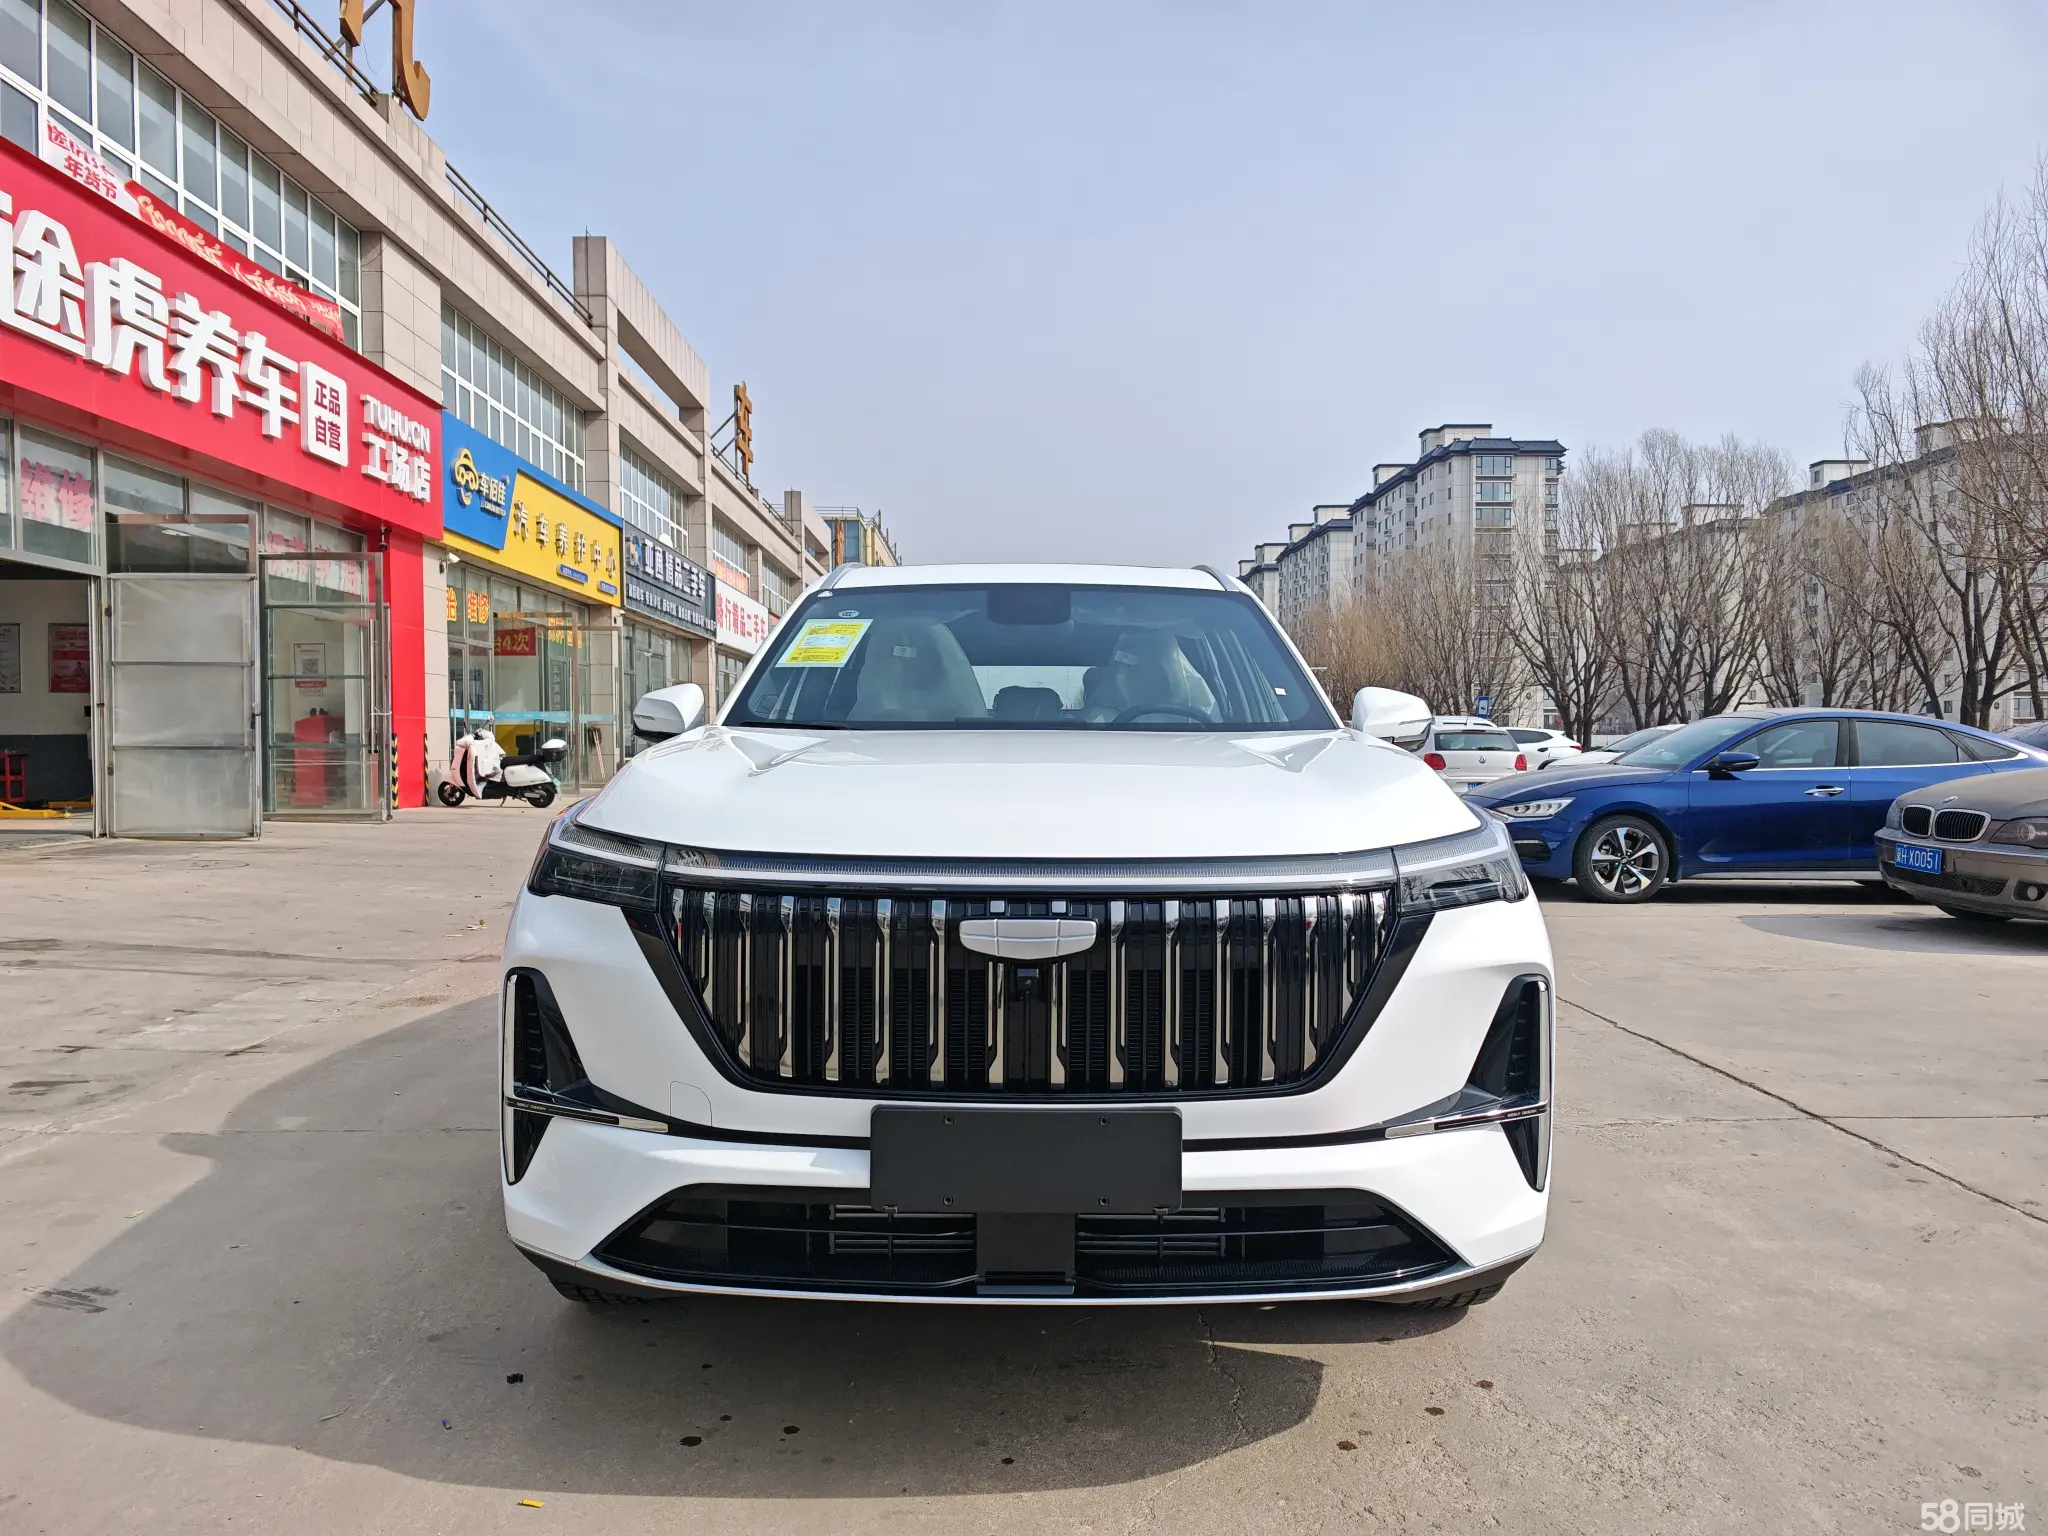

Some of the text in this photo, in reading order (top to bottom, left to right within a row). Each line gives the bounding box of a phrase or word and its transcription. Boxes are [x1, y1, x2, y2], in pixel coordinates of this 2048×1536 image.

[63, 154, 118, 200] 年货节
[0, 190, 300, 440] 途虎养车
[313, 379, 341, 418] 正品
[360, 394, 430, 454] TUHU.CN
[314, 415, 341, 453] 自营
[361, 432, 431, 503] 工场店
[513, 499, 617, 578] 汽车养护中心
[643, 537, 707, 601] 亚通精品二手车
